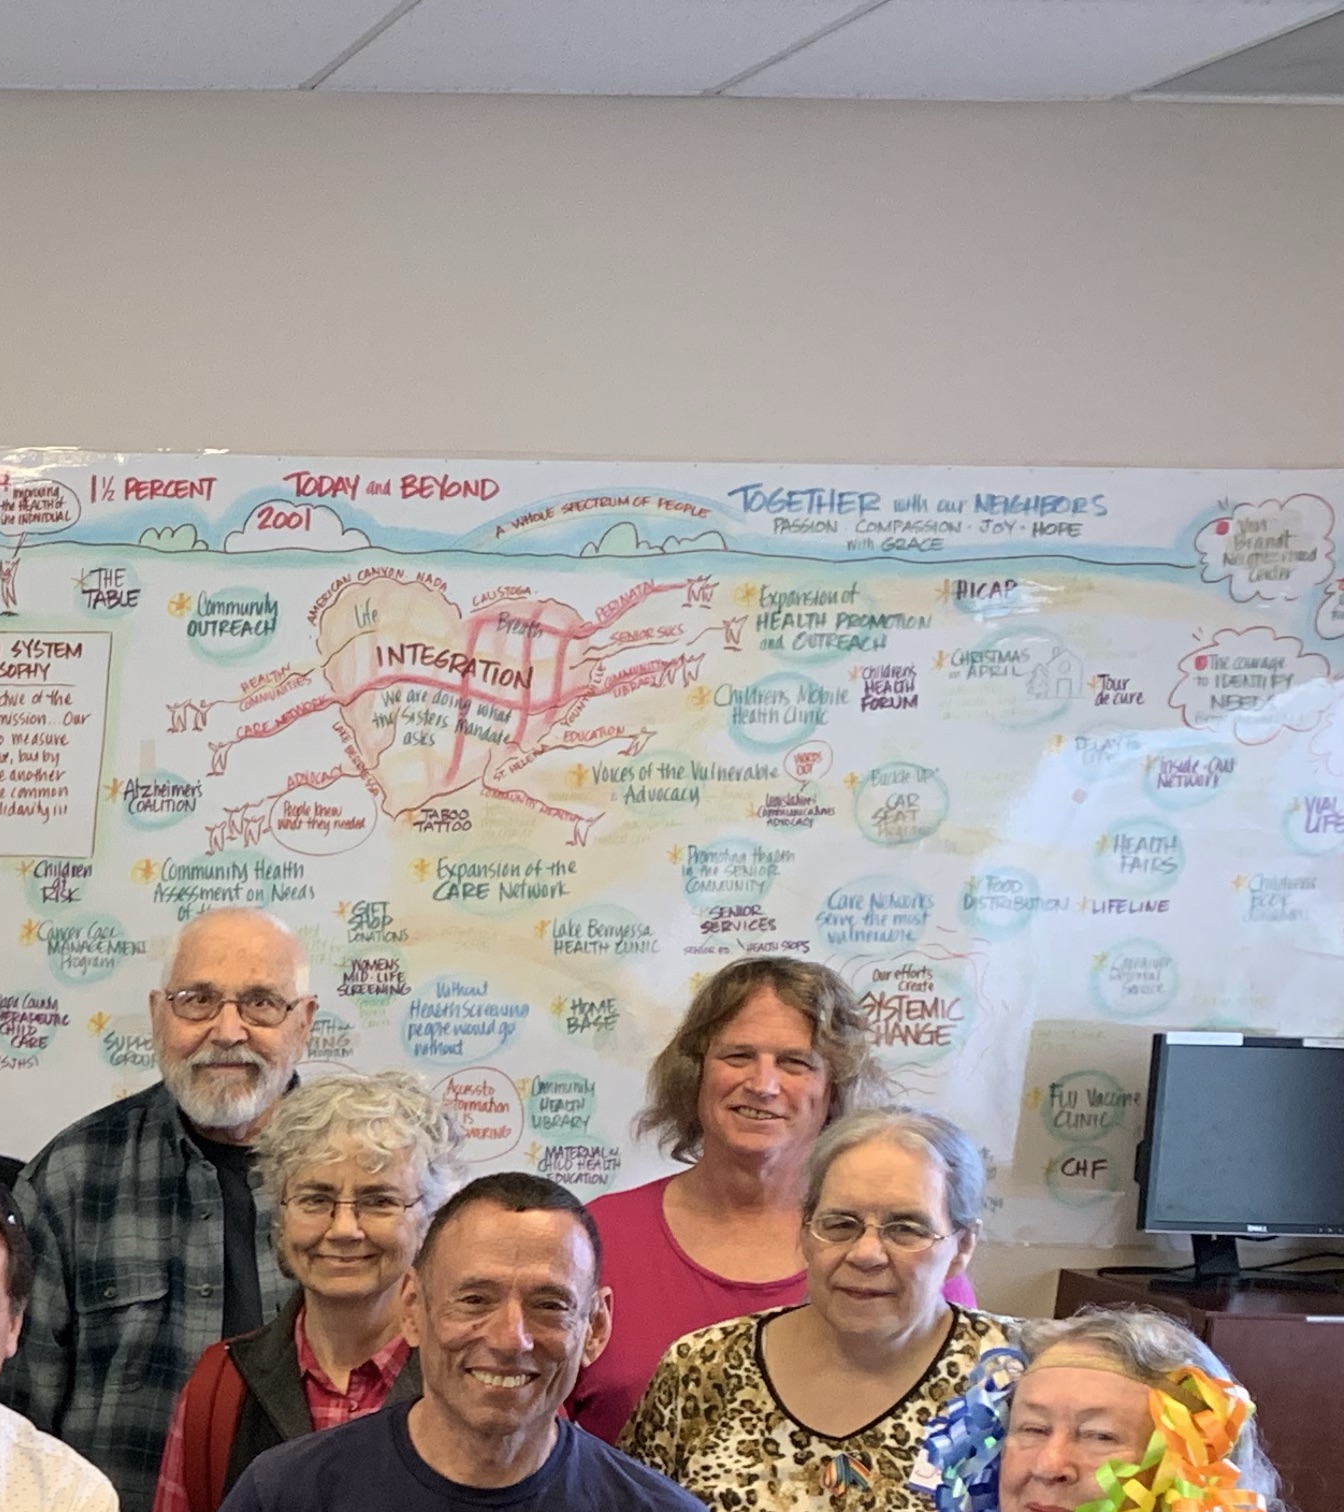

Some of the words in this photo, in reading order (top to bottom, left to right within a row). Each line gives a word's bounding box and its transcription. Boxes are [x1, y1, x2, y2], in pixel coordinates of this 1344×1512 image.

[124, 477, 217, 501] PERCENT
[283, 471, 360, 500] TODAY
[366, 479, 391, 496] and
[400, 473, 500, 500] BEYOND
[728, 483, 881, 515] TOGETHER
[894, 494, 929, 514] with
[936, 500, 968, 514] our
[973, 493, 1109, 517] NEIGHBORS
[257, 506, 311, 531] 2001
[773, 516, 838, 534] PASSION
[854, 518, 963, 534] COMPASSION
[1032, 521, 1084, 538] HOPE
[881, 536, 945, 553] GRACE
[91, 567, 127, 589] THE
[81, 588, 141, 609] TABLE
[197, 590, 279, 619] Community
[187, 620, 277, 638] OUTREACH
[756, 611, 828, 633] HEALTH
[835, 612, 932, 632] PROMOTION
[11, 640, 83, 659] SYSTEM
[792, 632, 888, 653] OUTREACH
[375, 643, 535, 692] INTEGRATION
[691, 759, 781, 783] Vulnerable
[623, 785, 700, 808] Advocacy
[1114, 833, 1177, 853] HEALTH
[160, 856, 249, 882] Community
[437, 856, 516, 880] Expansion
[1120, 855, 1178, 875] FAIRS
[153, 882, 242, 903] Assessment
[271, 880, 316, 902] Needs
[431, 880, 491, 902] CARE
[499, 879, 571, 902] Network
[963, 892, 1070, 913] DISTRIBUTION
[1092, 899, 1171, 915] LIFELINE
[700, 916, 777, 935] SERVICES
[862, 991, 965, 1022] SYSTEMIC
[566, 1012, 620, 1035] BASE
[1053, 1109, 1112, 1129] CLINIC
[1061, 1157, 1109, 1180] CHF
